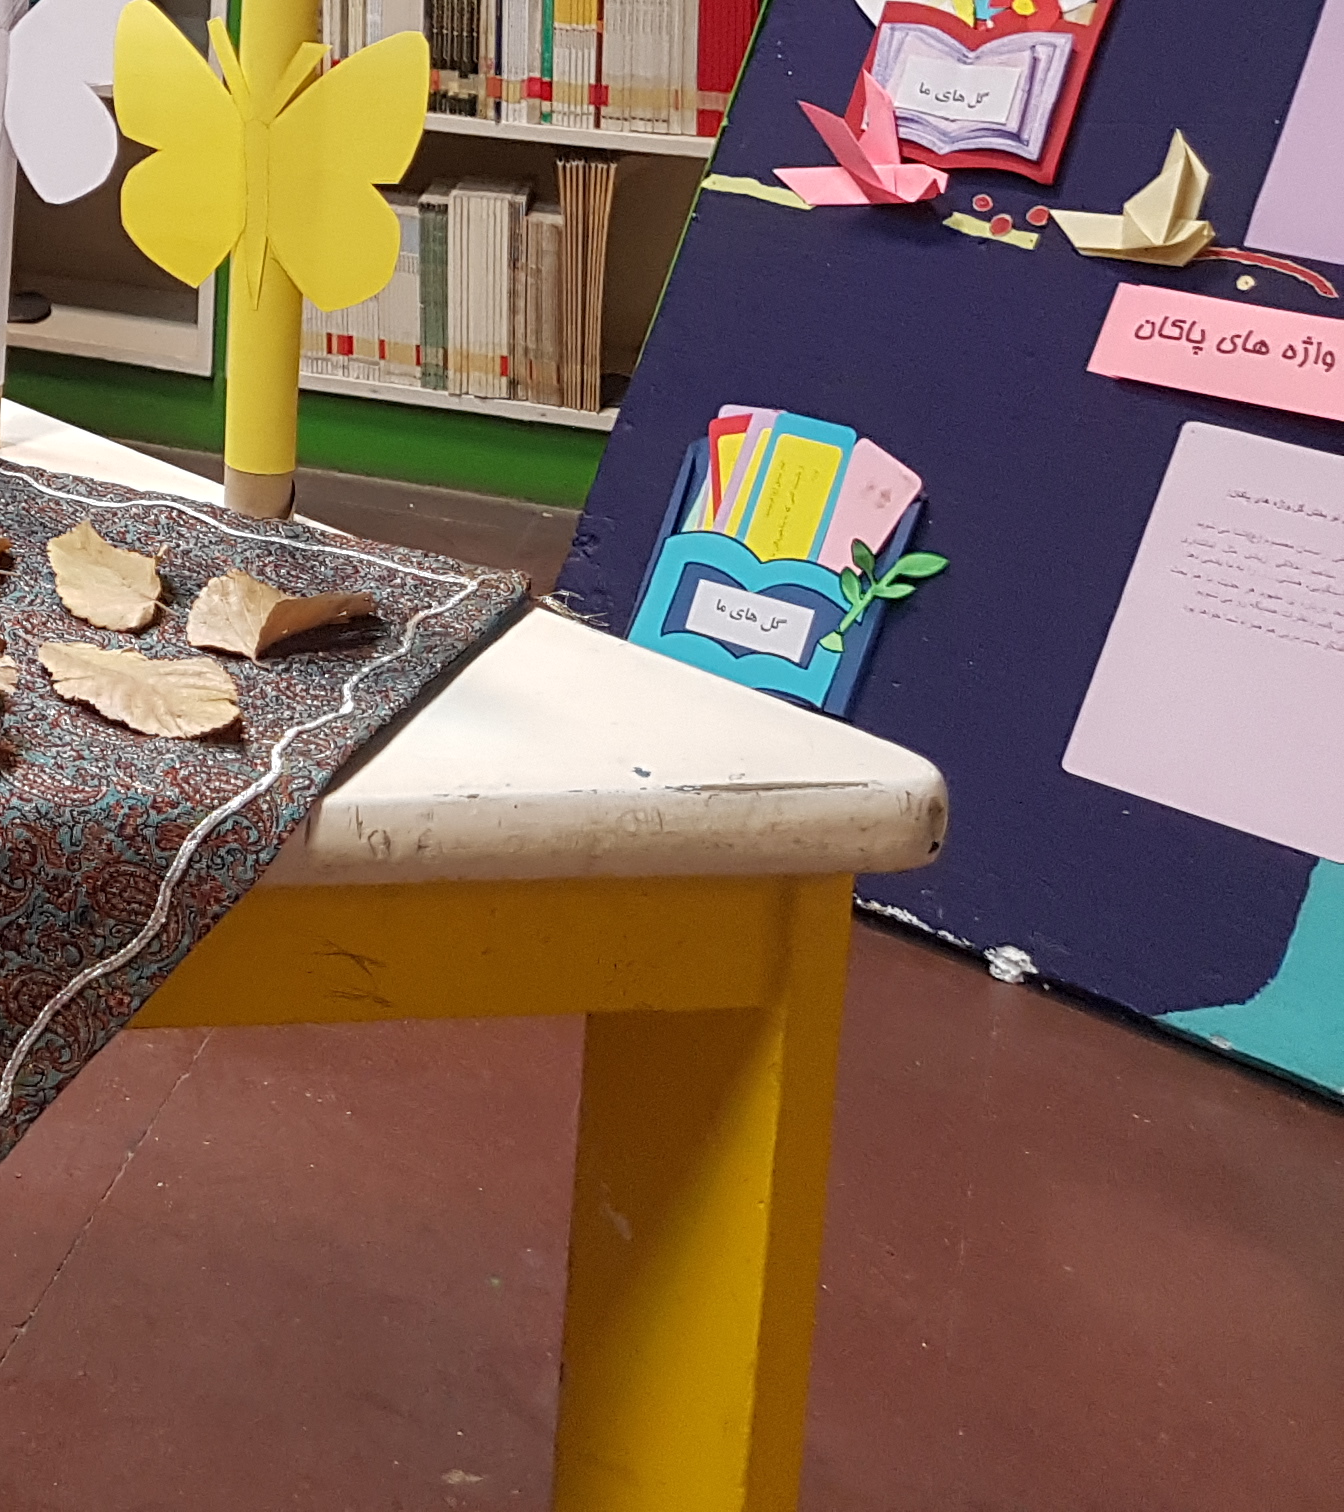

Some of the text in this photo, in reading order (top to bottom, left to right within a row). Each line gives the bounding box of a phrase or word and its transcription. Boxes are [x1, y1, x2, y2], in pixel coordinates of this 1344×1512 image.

[918, 81, 990, 109] گل های ما
[1133, 315, 1337, 373] واژه های پاکان
[715, 598, 788, 633] گل های ما
